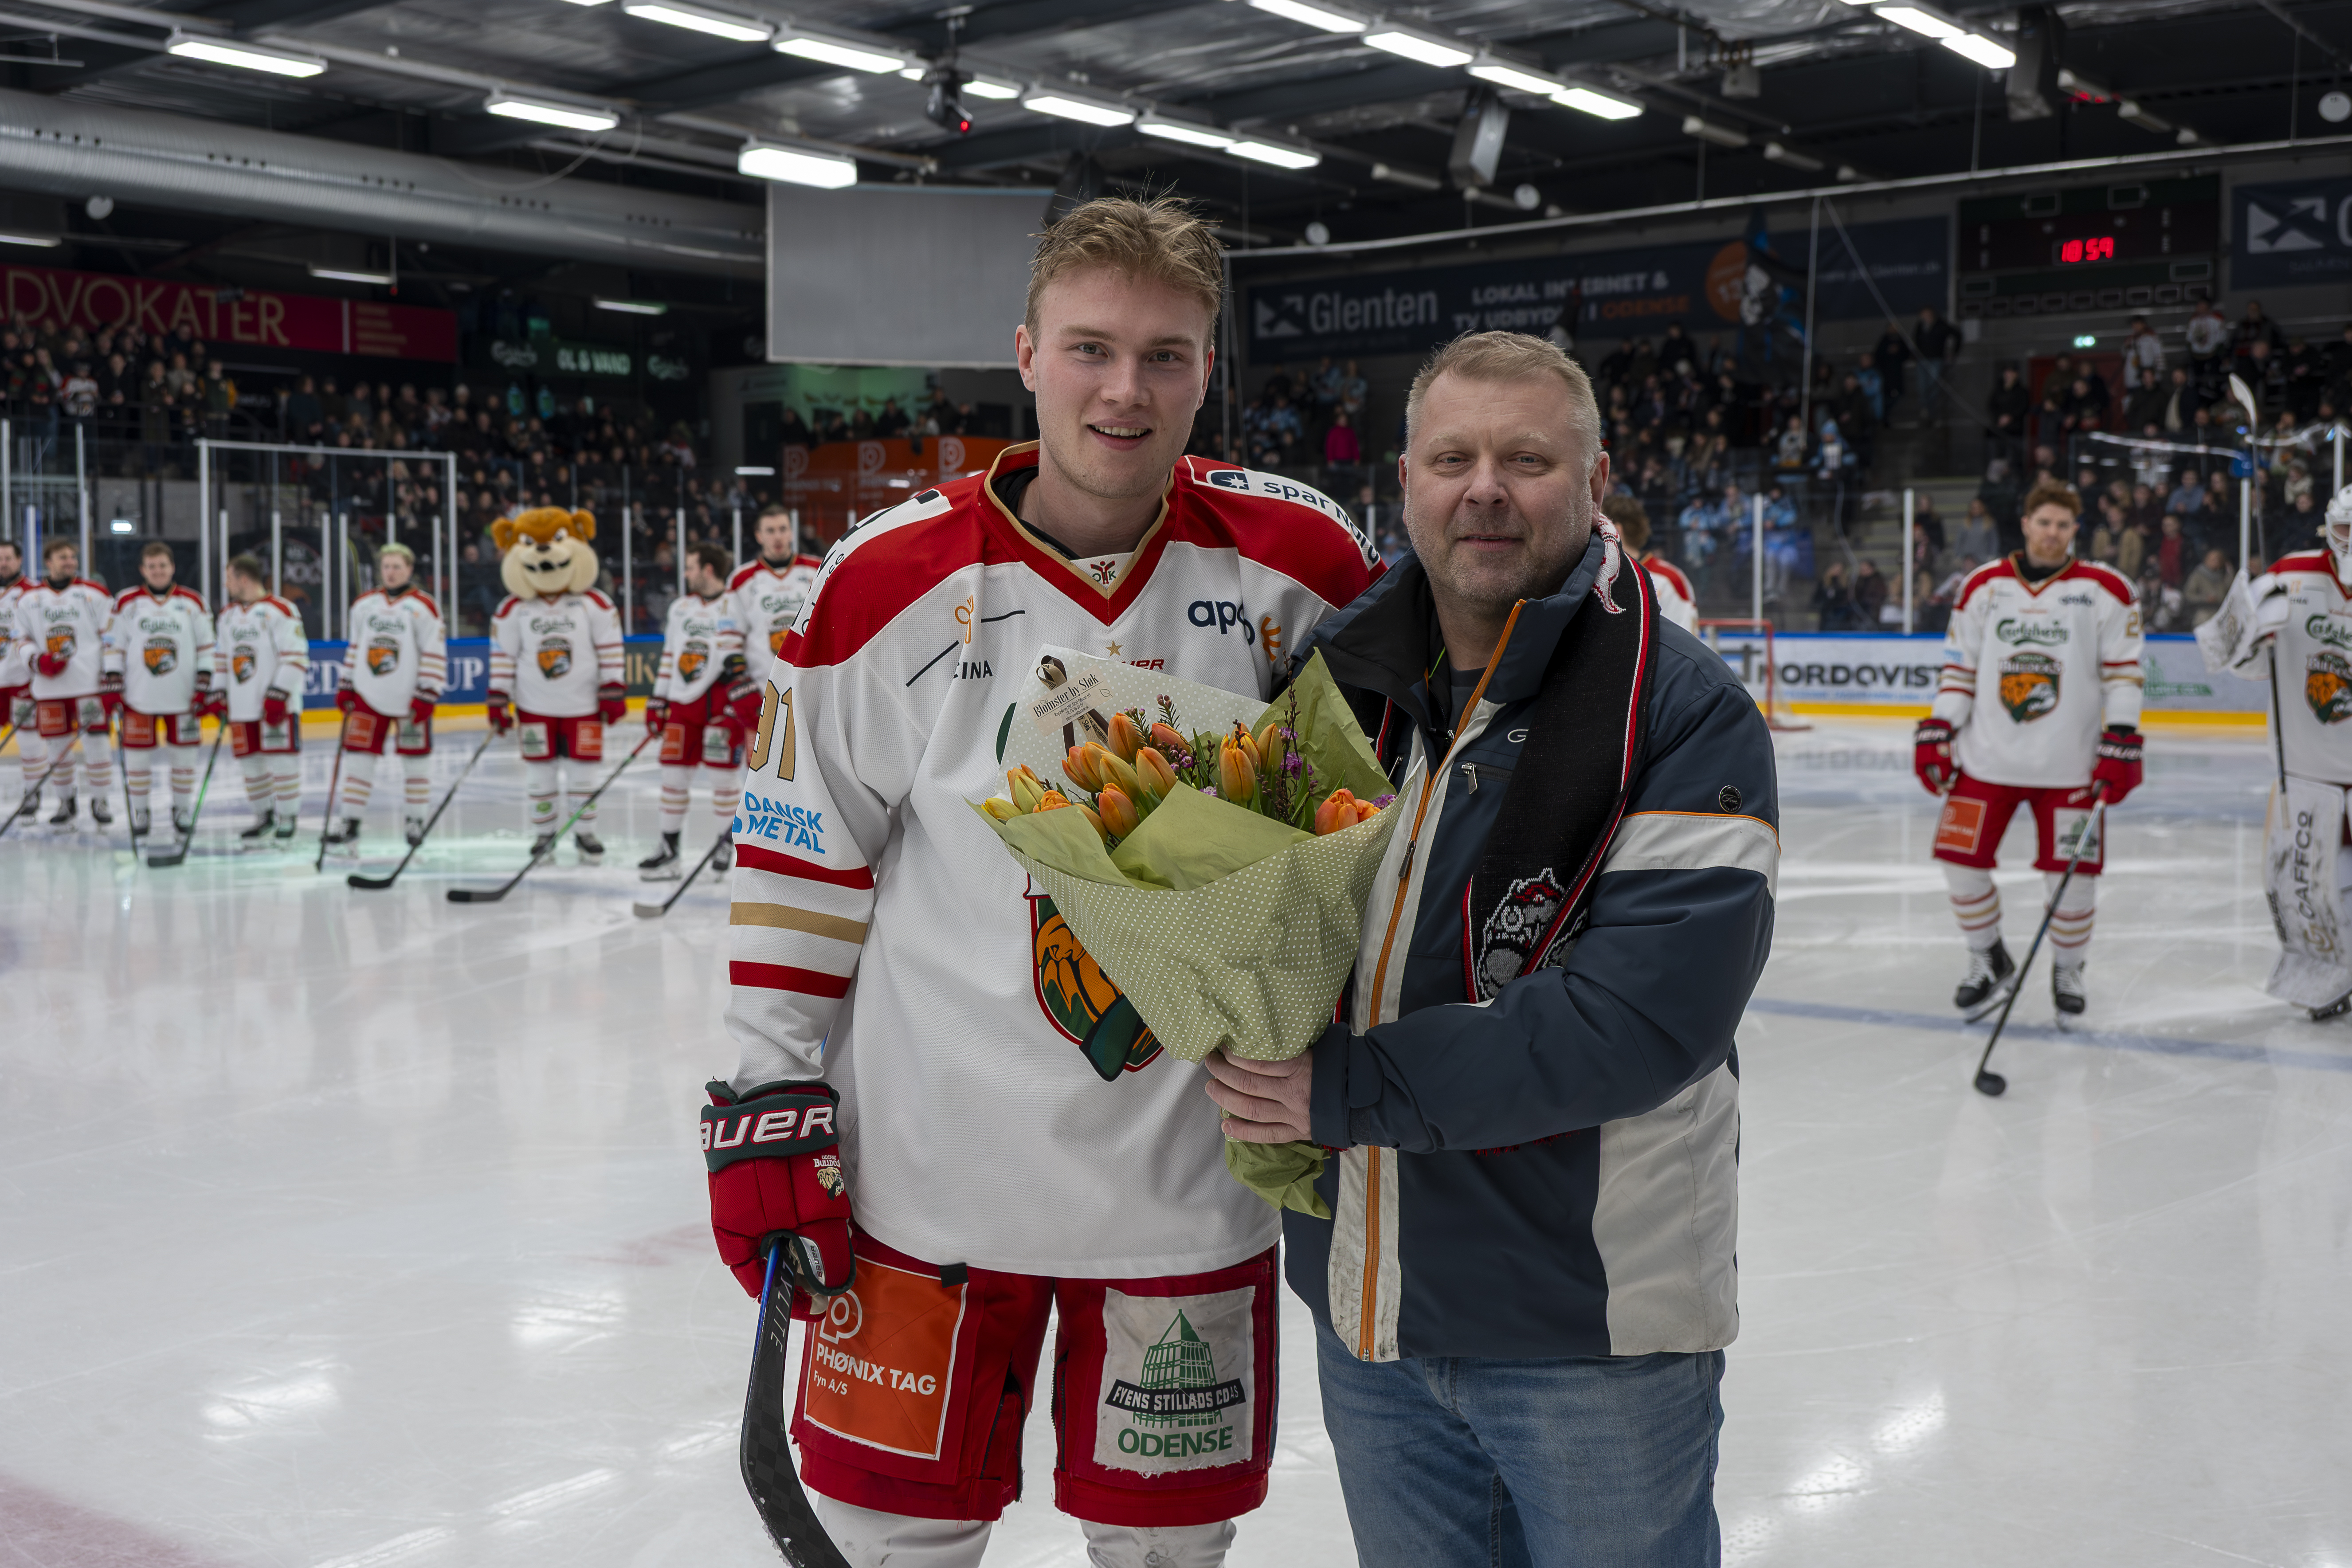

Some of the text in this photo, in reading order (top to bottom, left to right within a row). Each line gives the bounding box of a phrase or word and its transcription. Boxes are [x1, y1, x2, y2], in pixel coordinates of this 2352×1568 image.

[0, 270, 290, 346] DVOKATER
[1308, 286, 1438, 335] Glenten
[1471, 282, 1539, 307] LOKAL
[1601, 294, 1691, 321] ODENSE
[1997, 618, 2070, 642] Carlsberg
[953, 660, 993, 679] INA
[1033, 673, 1099, 717] Blomster by Sløk
[745, 791, 824, 833] DANSK
[747, 813, 826, 855] METAL
[700, 1105, 835, 1152] AUER
[812, 1159, 841, 1168] BULLDOG
[810, 1245, 823, 1278] BAUER
[813, 1370, 848, 1396] Fyn A/S
[816, 1342, 937, 1396] PHØNIX TAG
[1112, 1386, 1150, 1410] FYENS
[1154, 1391, 1214, 1411] STILLADS
[1216, 1388, 1230, 1405] CO
[1117, 1426, 1233, 1458] ODENSE
